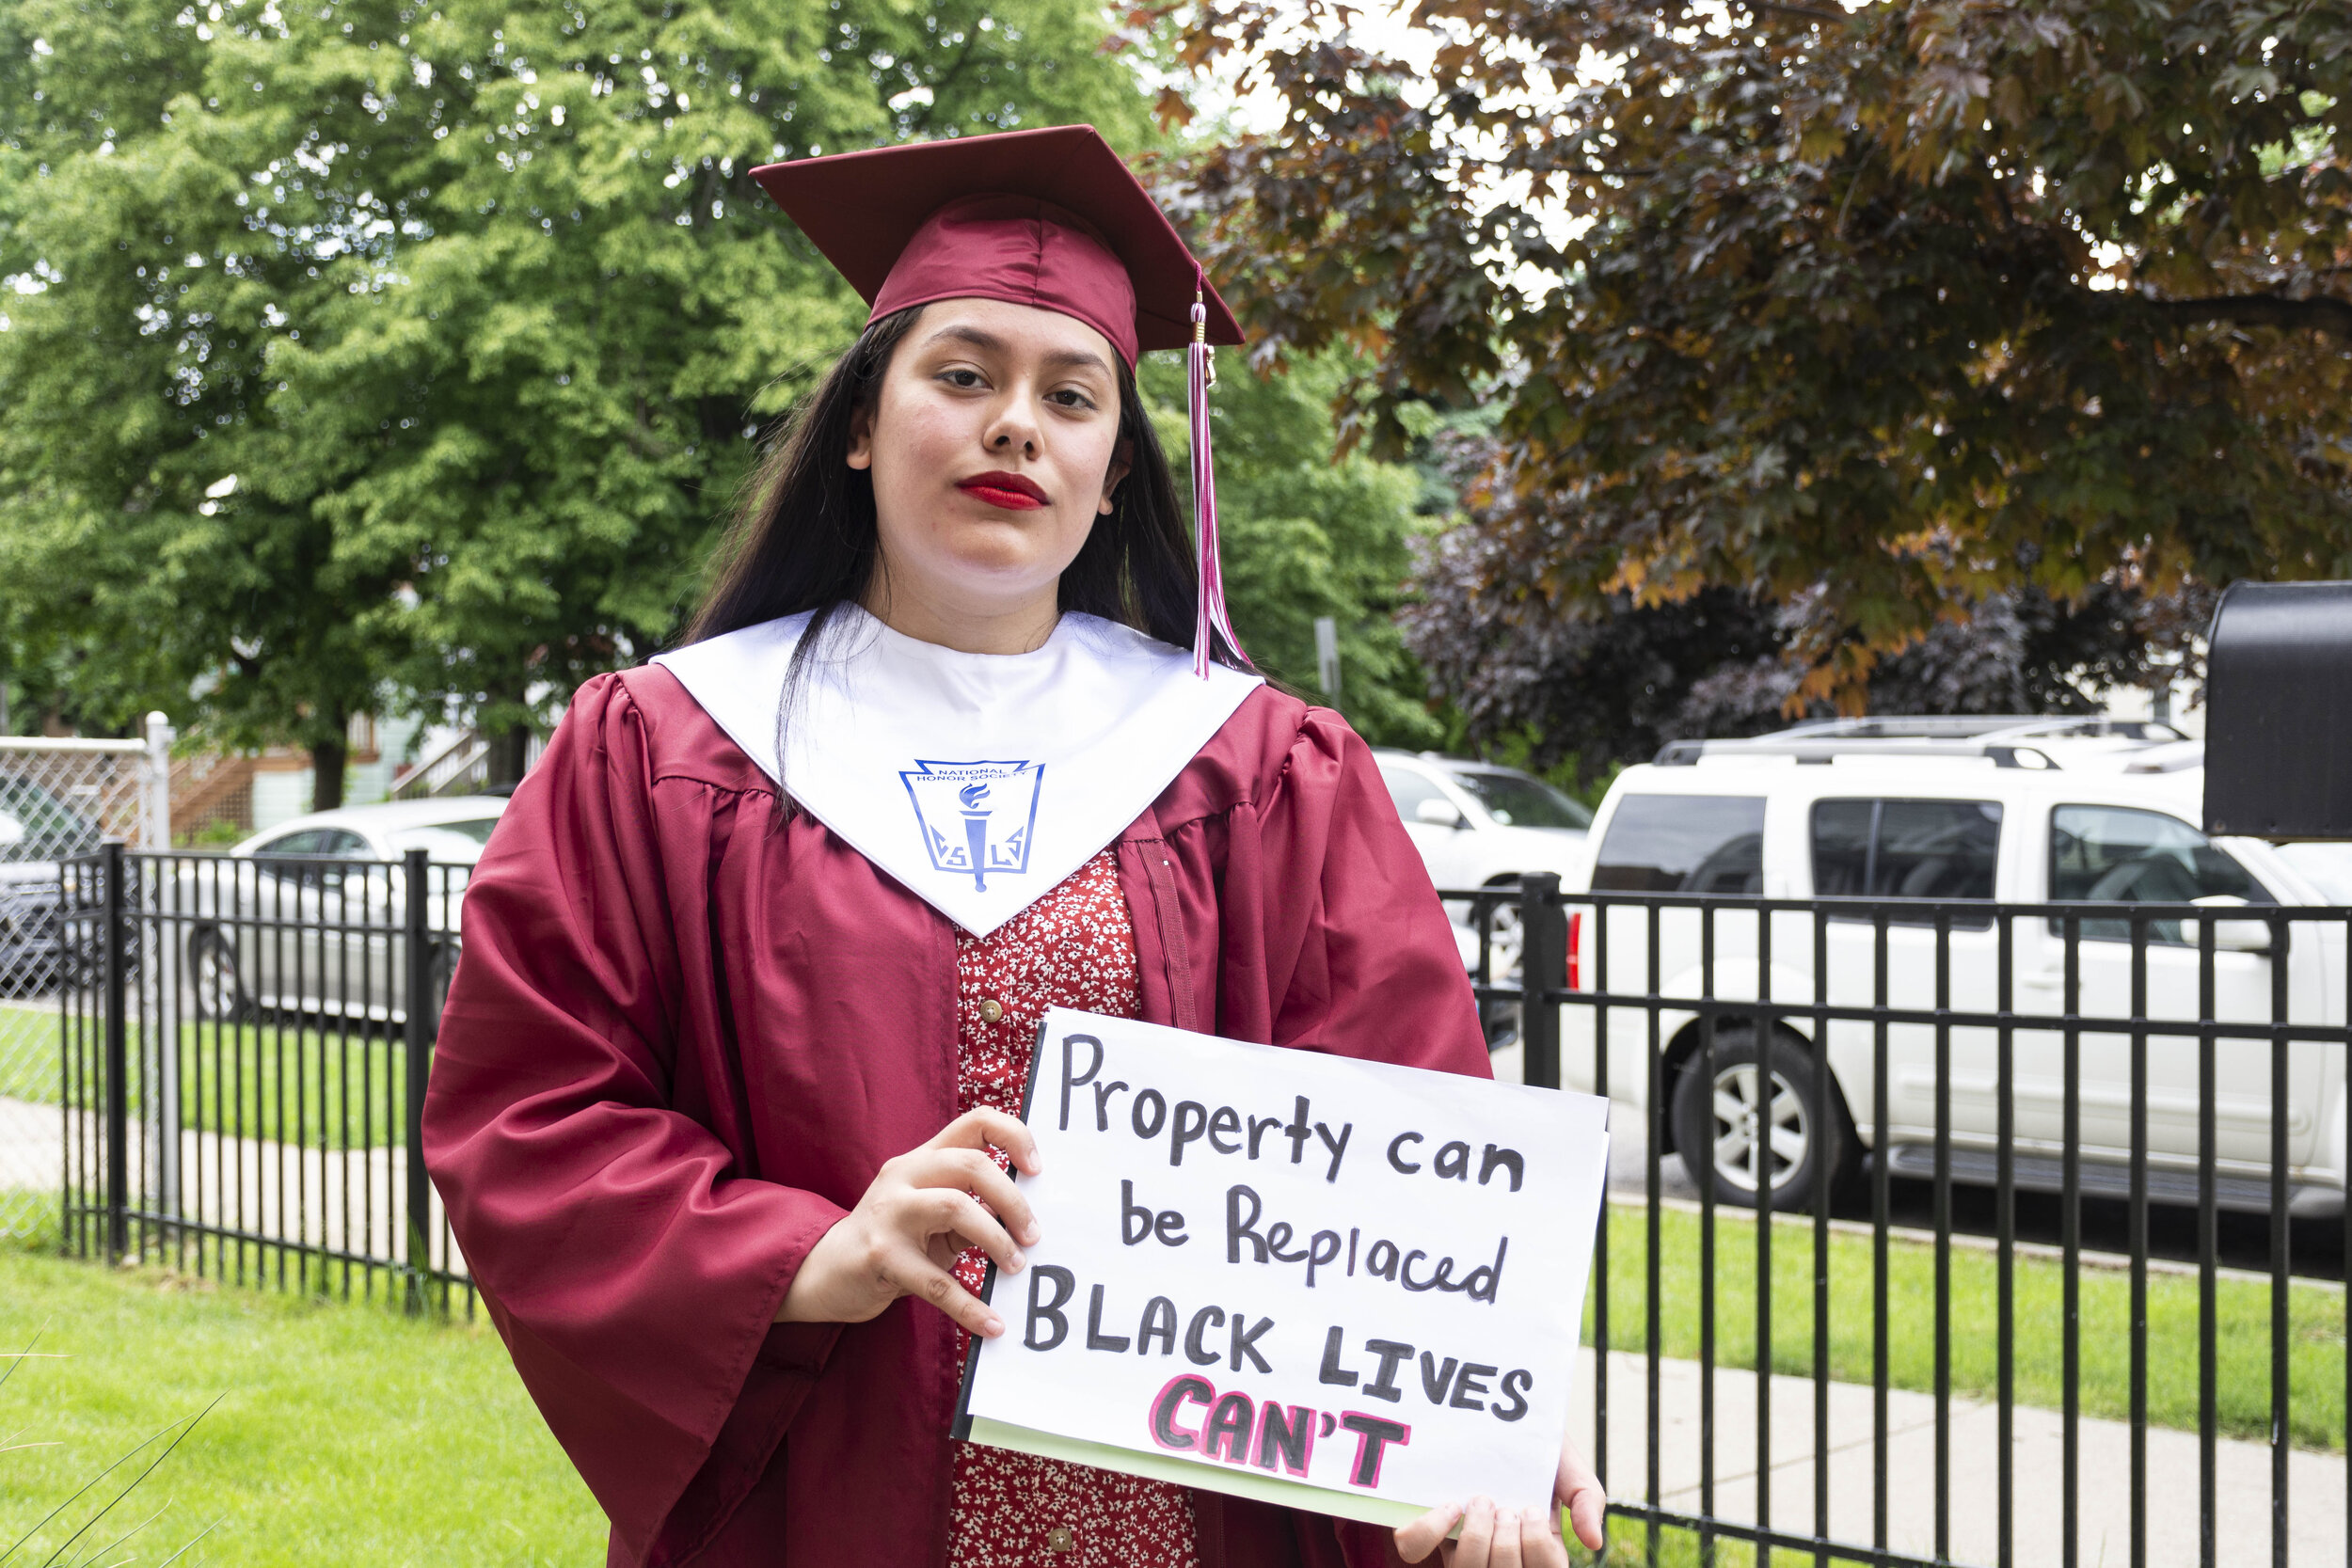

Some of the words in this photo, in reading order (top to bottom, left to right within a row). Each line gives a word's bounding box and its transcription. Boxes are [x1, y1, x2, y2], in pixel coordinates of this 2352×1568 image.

[938, 768, 1007, 776] NATIONAL
[970, 770, 1027, 782] SOCIETY
[1058, 1034, 1353, 1183] Property
[1387, 1132, 1524, 1193] can
[1120, 1179, 1189, 1246] be
[1226, 1184, 1509, 1306] Replaced
[1023, 1264, 1275, 1374] BLACK
[1318, 1325, 1534, 1422] LIVES
[1148, 1373, 1412, 1489] CAN'T
